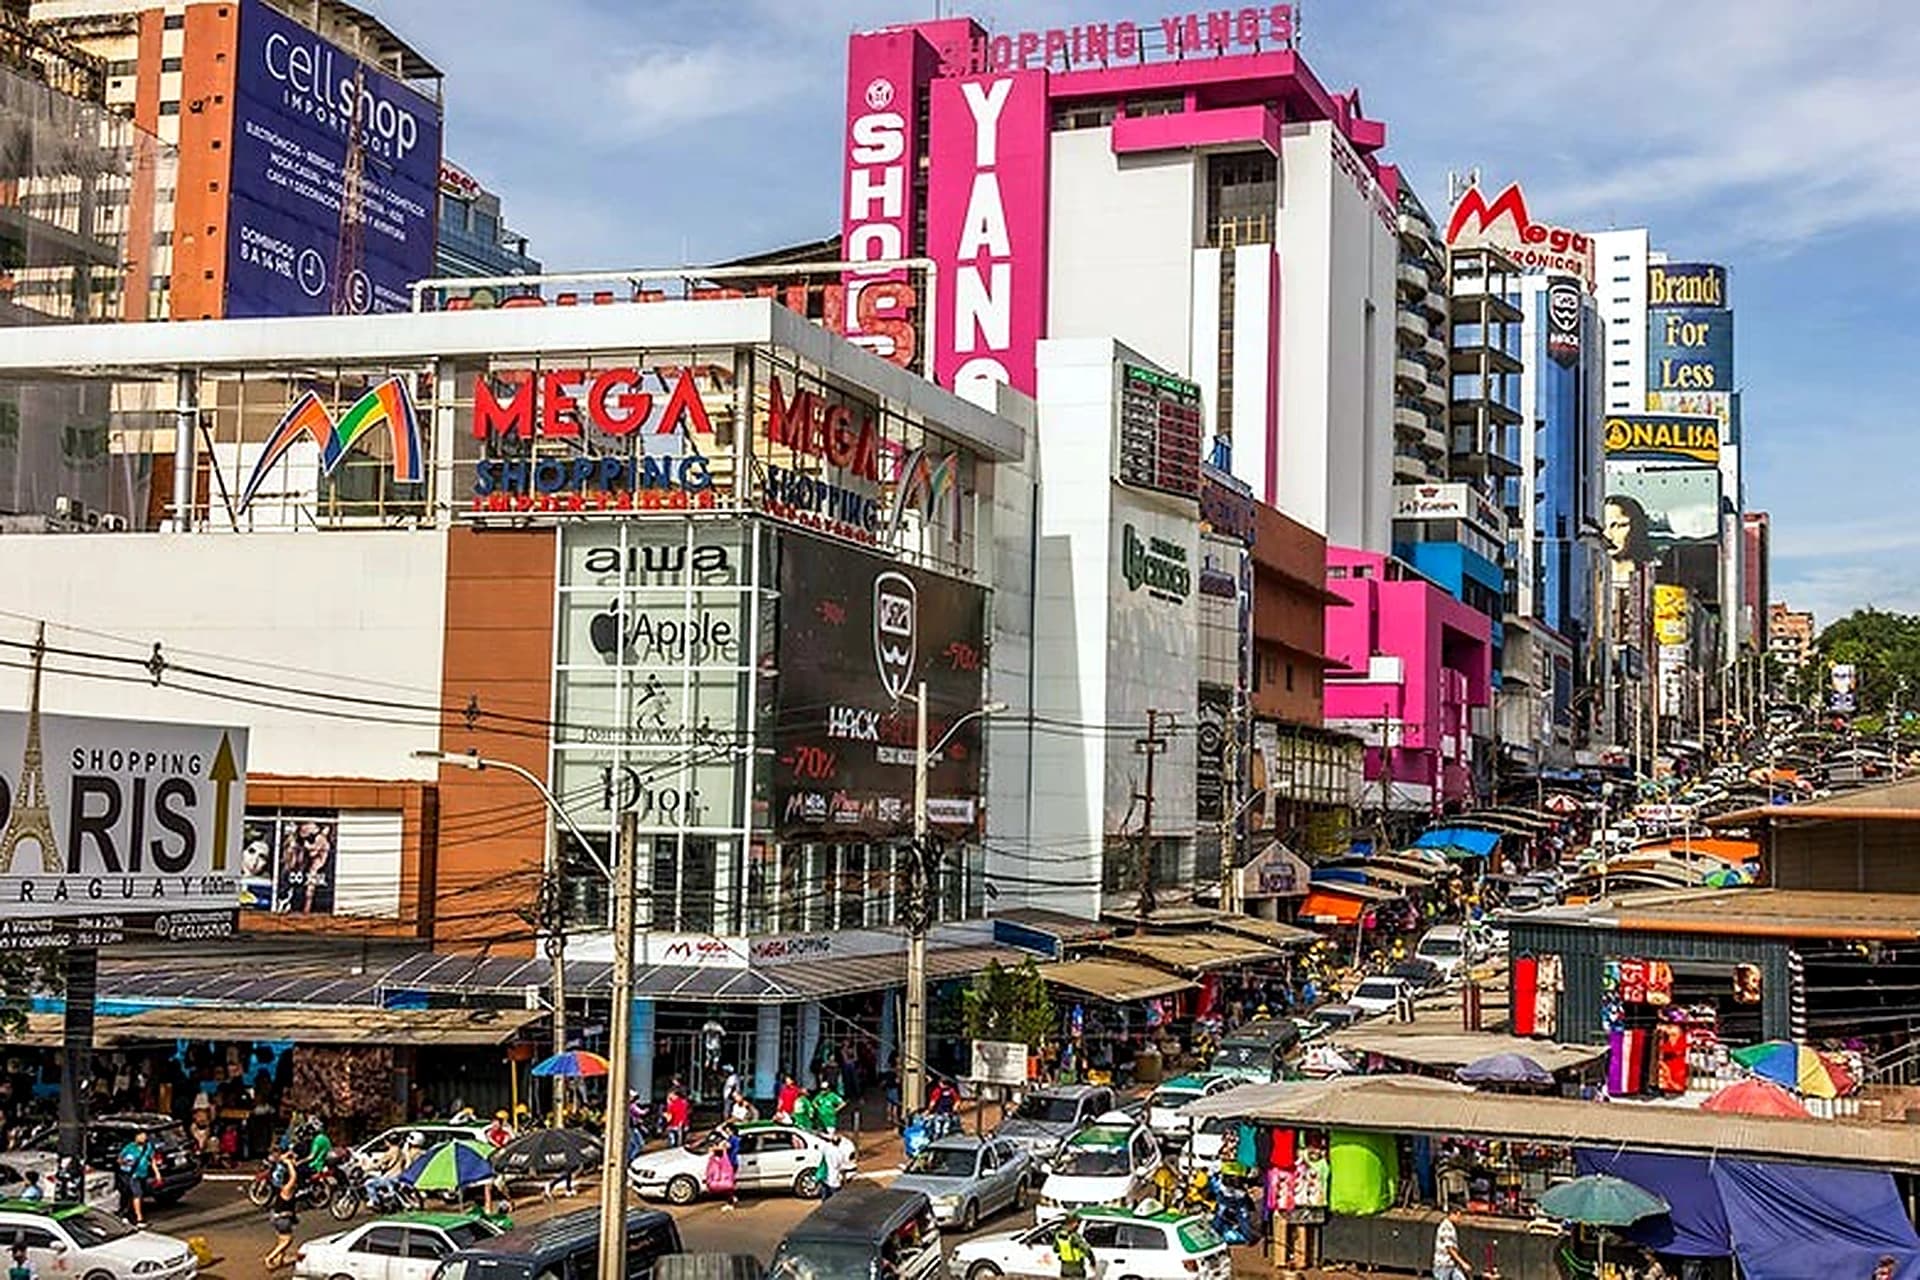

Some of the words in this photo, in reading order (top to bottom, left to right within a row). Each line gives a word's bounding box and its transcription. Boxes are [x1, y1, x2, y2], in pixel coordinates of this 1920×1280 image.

[1667, 315, 1710, 348] For
[1662, 358, 1715, 388] Less
[471, 368, 713, 440] MEGA
[768, 375, 879, 482] MEGA
[473, 455, 713, 497] SHOPPING
[585, 545, 729, 573] aiwa
[631, 612, 731, 653] Apple
[827, 705, 881, 741] HACK
[72, 748, 201, 775] SHOPPING
[780, 746, 836, 779] -70%
